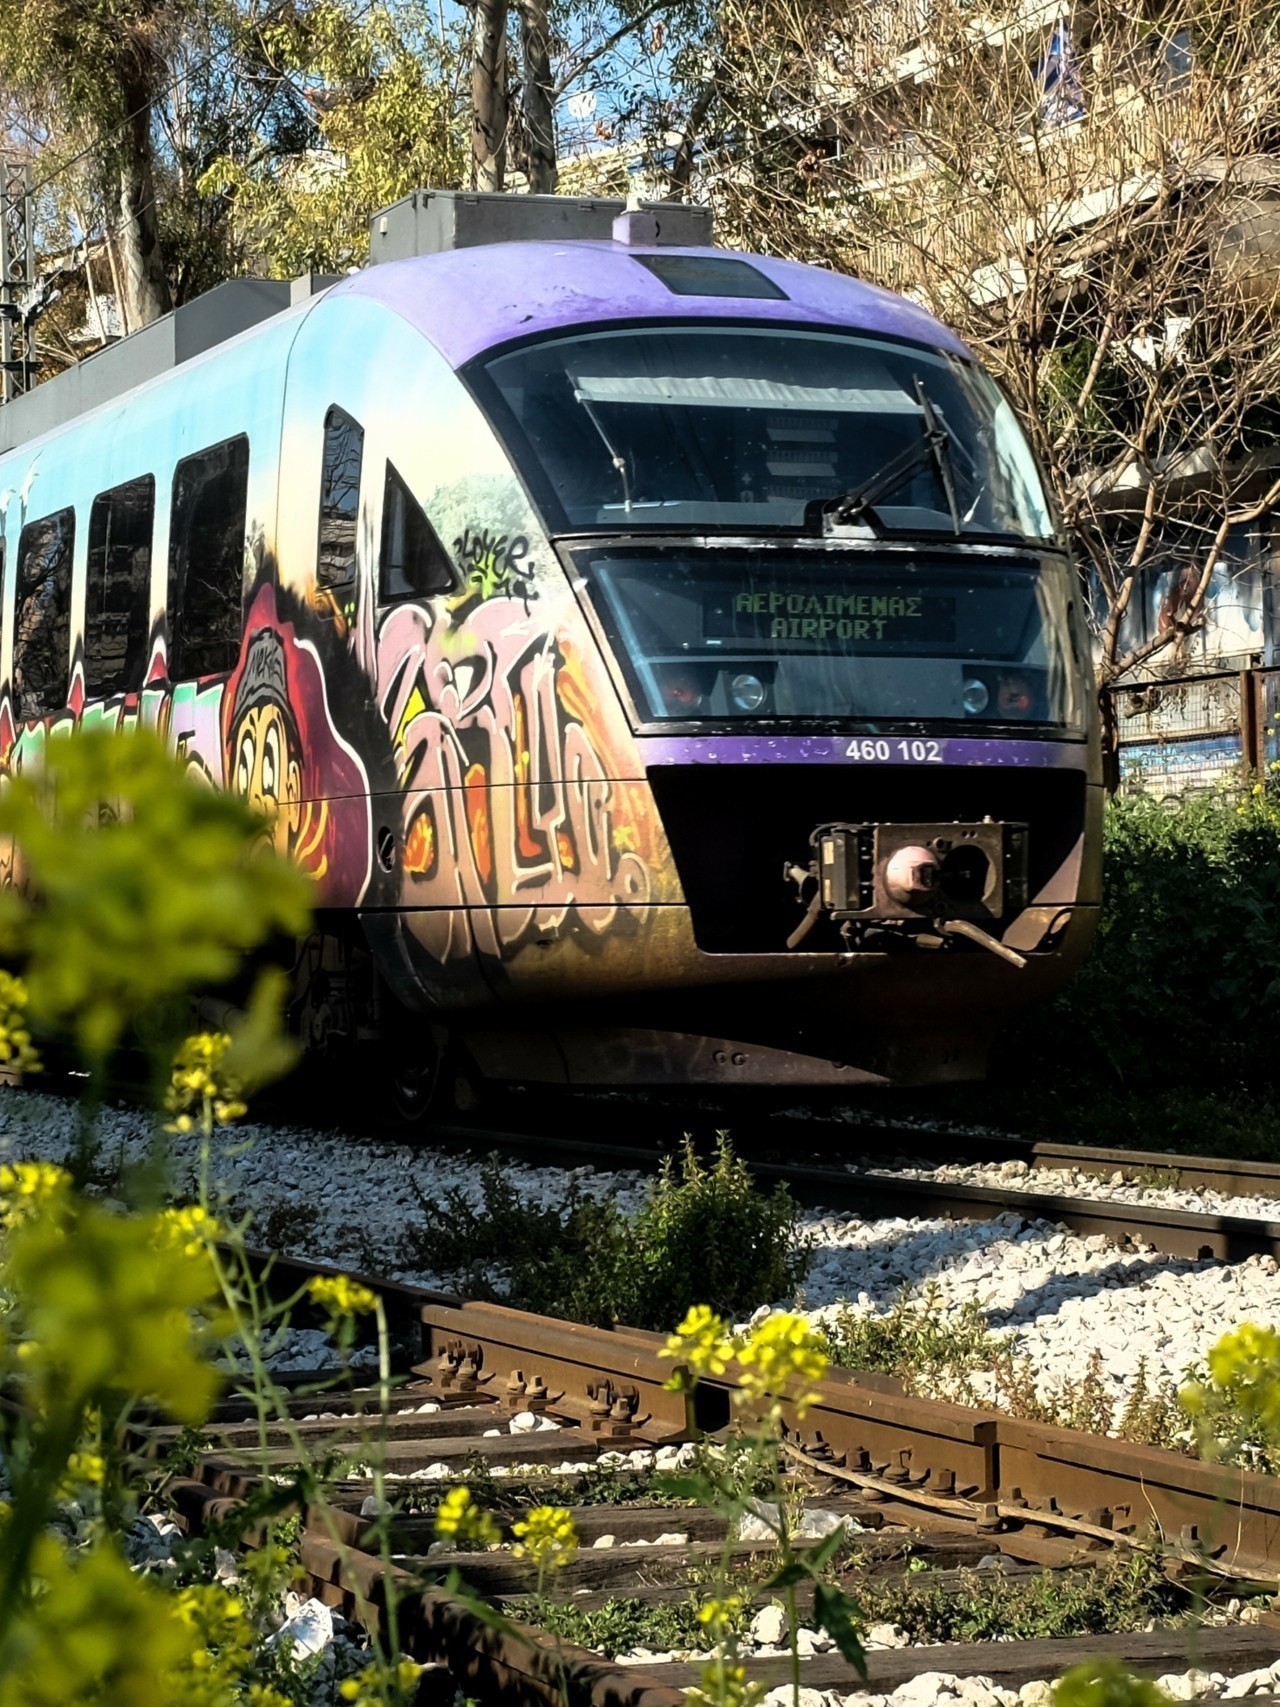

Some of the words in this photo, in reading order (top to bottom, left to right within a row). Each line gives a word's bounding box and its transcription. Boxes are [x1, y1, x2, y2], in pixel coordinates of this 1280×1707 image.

[771, 617, 887, 640] AIRPORT
[845, 740, 890, 761] 460
[897, 740, 942, 763] 102
